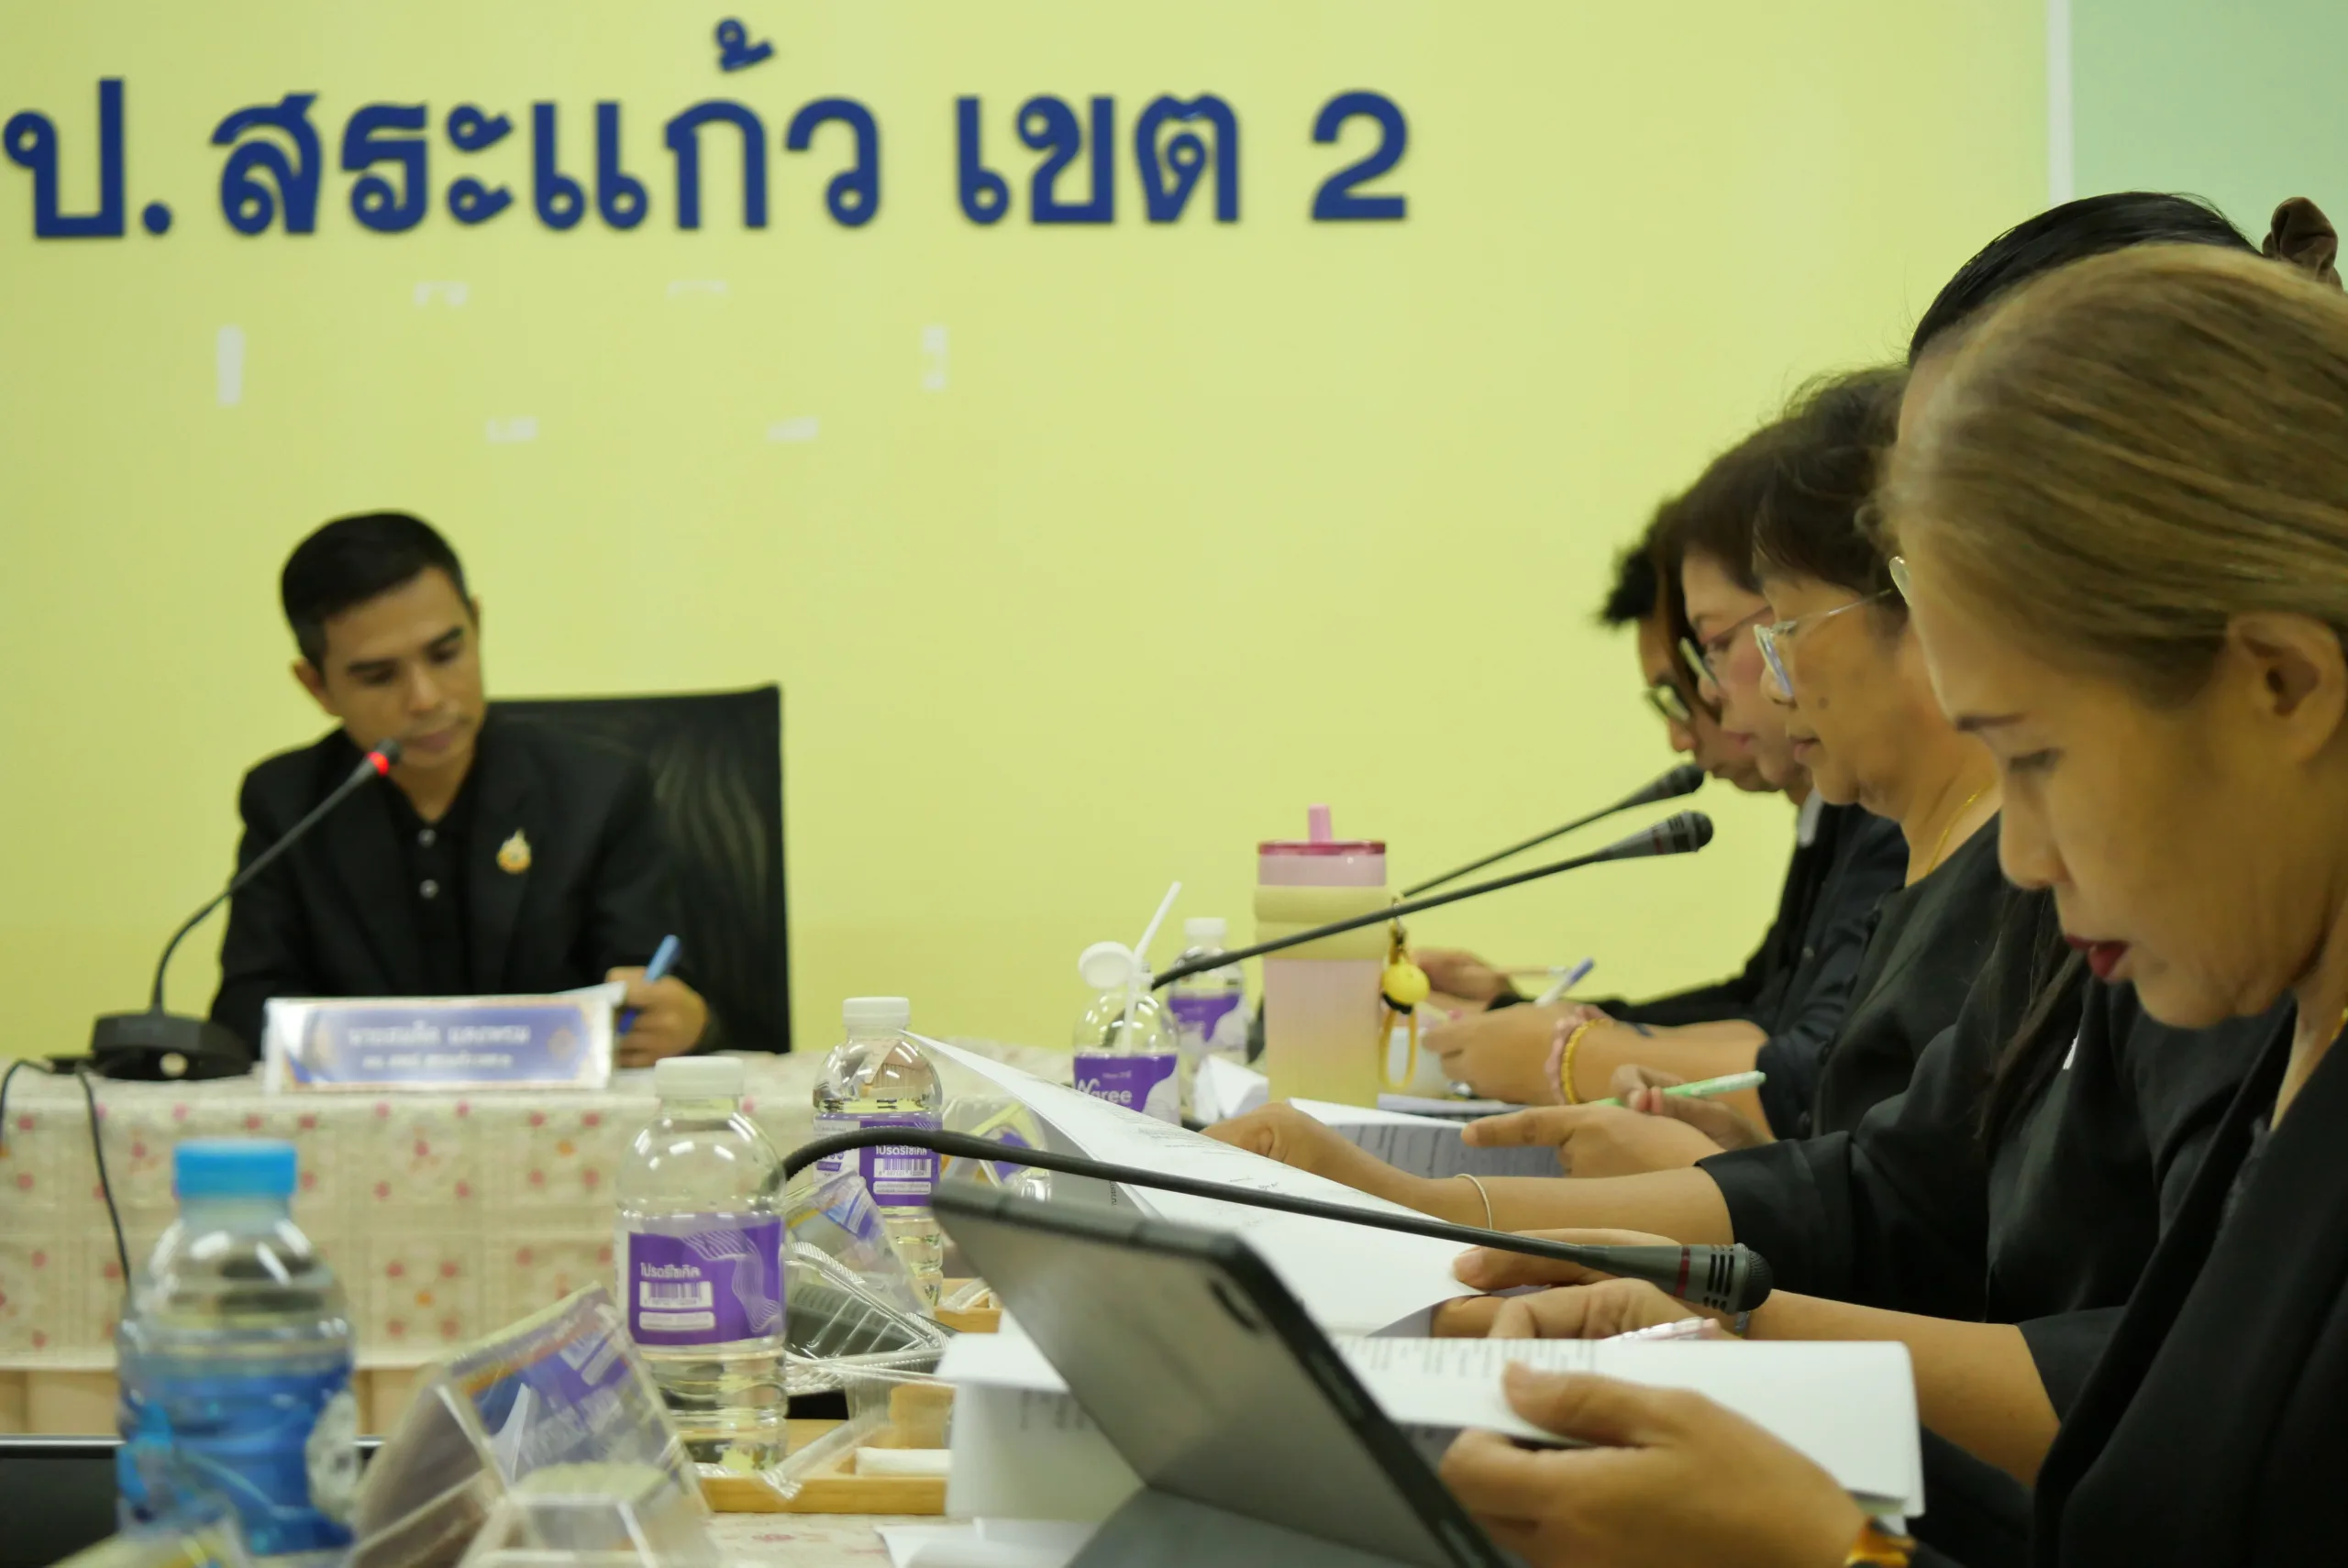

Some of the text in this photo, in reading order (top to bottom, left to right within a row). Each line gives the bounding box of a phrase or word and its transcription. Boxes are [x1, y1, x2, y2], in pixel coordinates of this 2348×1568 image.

[3, 18, 1407, 237] ป. สระแก้ว เขต 2
